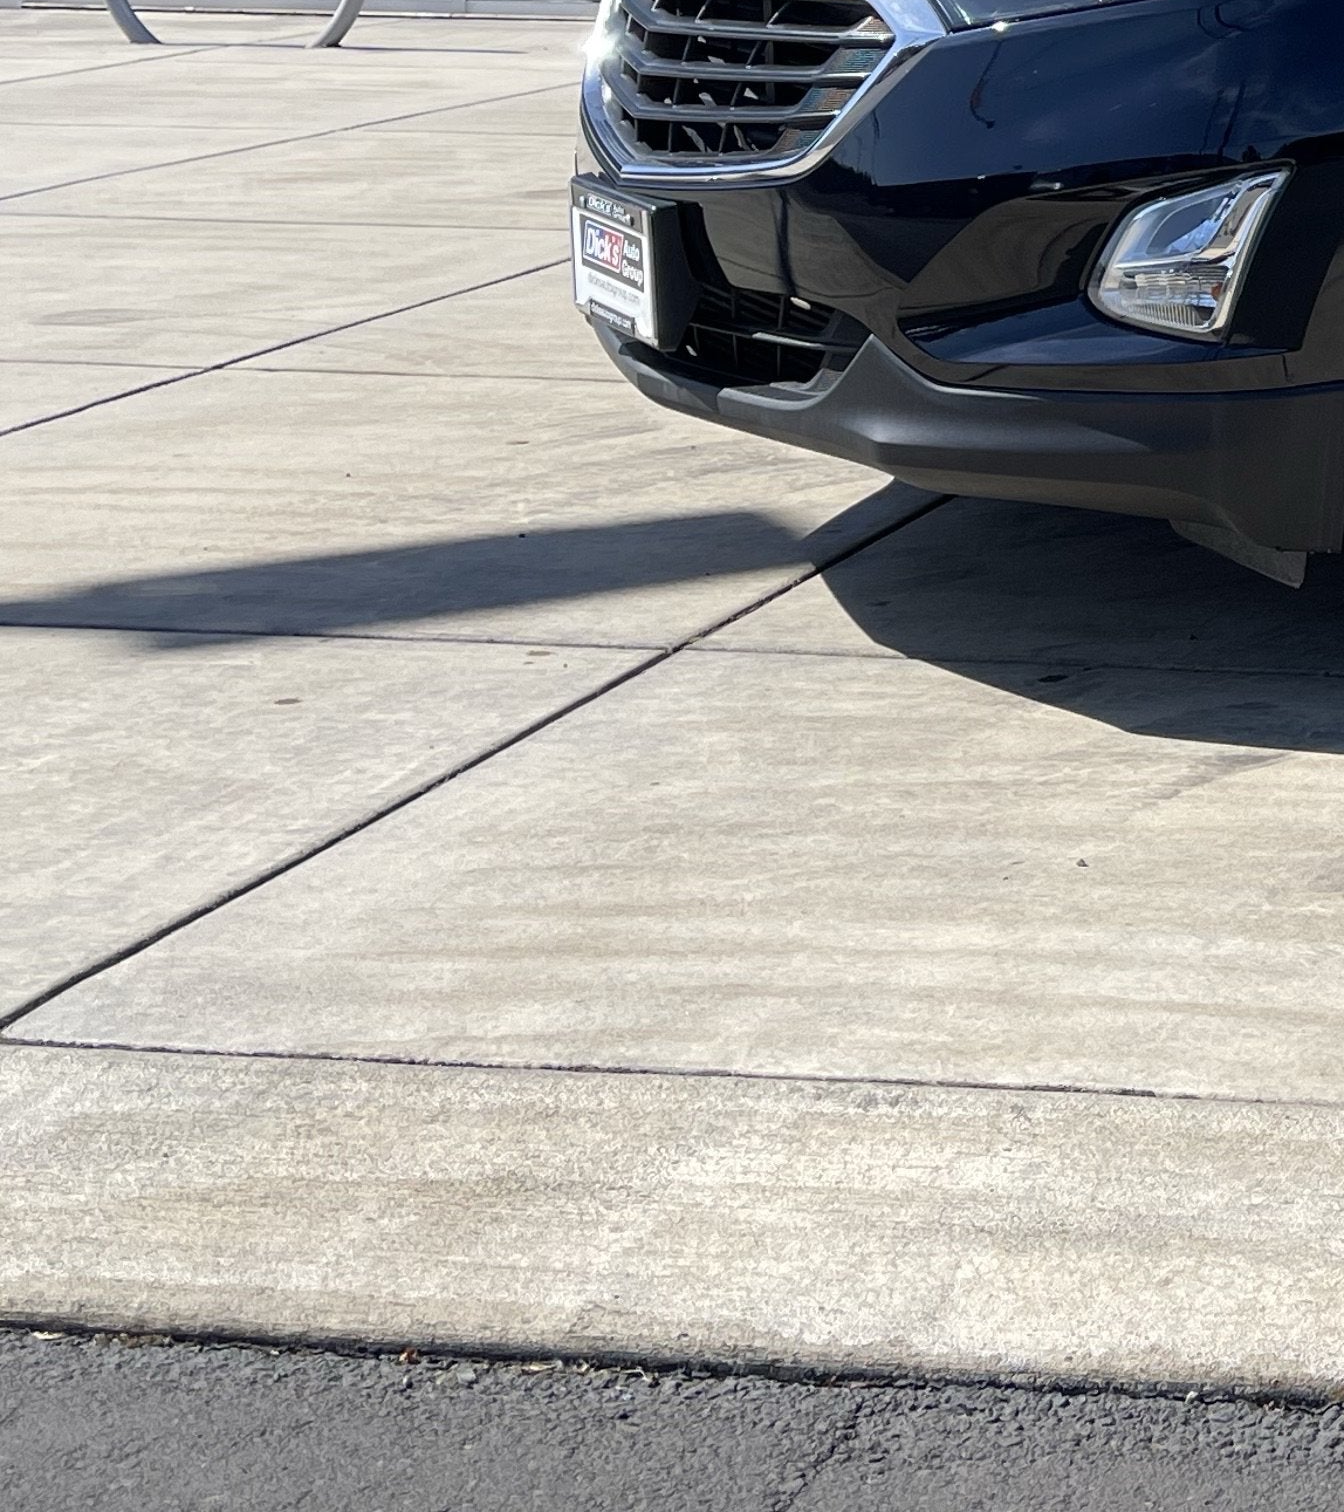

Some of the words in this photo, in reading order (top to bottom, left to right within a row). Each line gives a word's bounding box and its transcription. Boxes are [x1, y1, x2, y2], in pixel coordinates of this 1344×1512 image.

[585, 227, 620, 267] Dick's
[623, 239, 640, 262] Auto
[621, 259, 644, 288] Group
